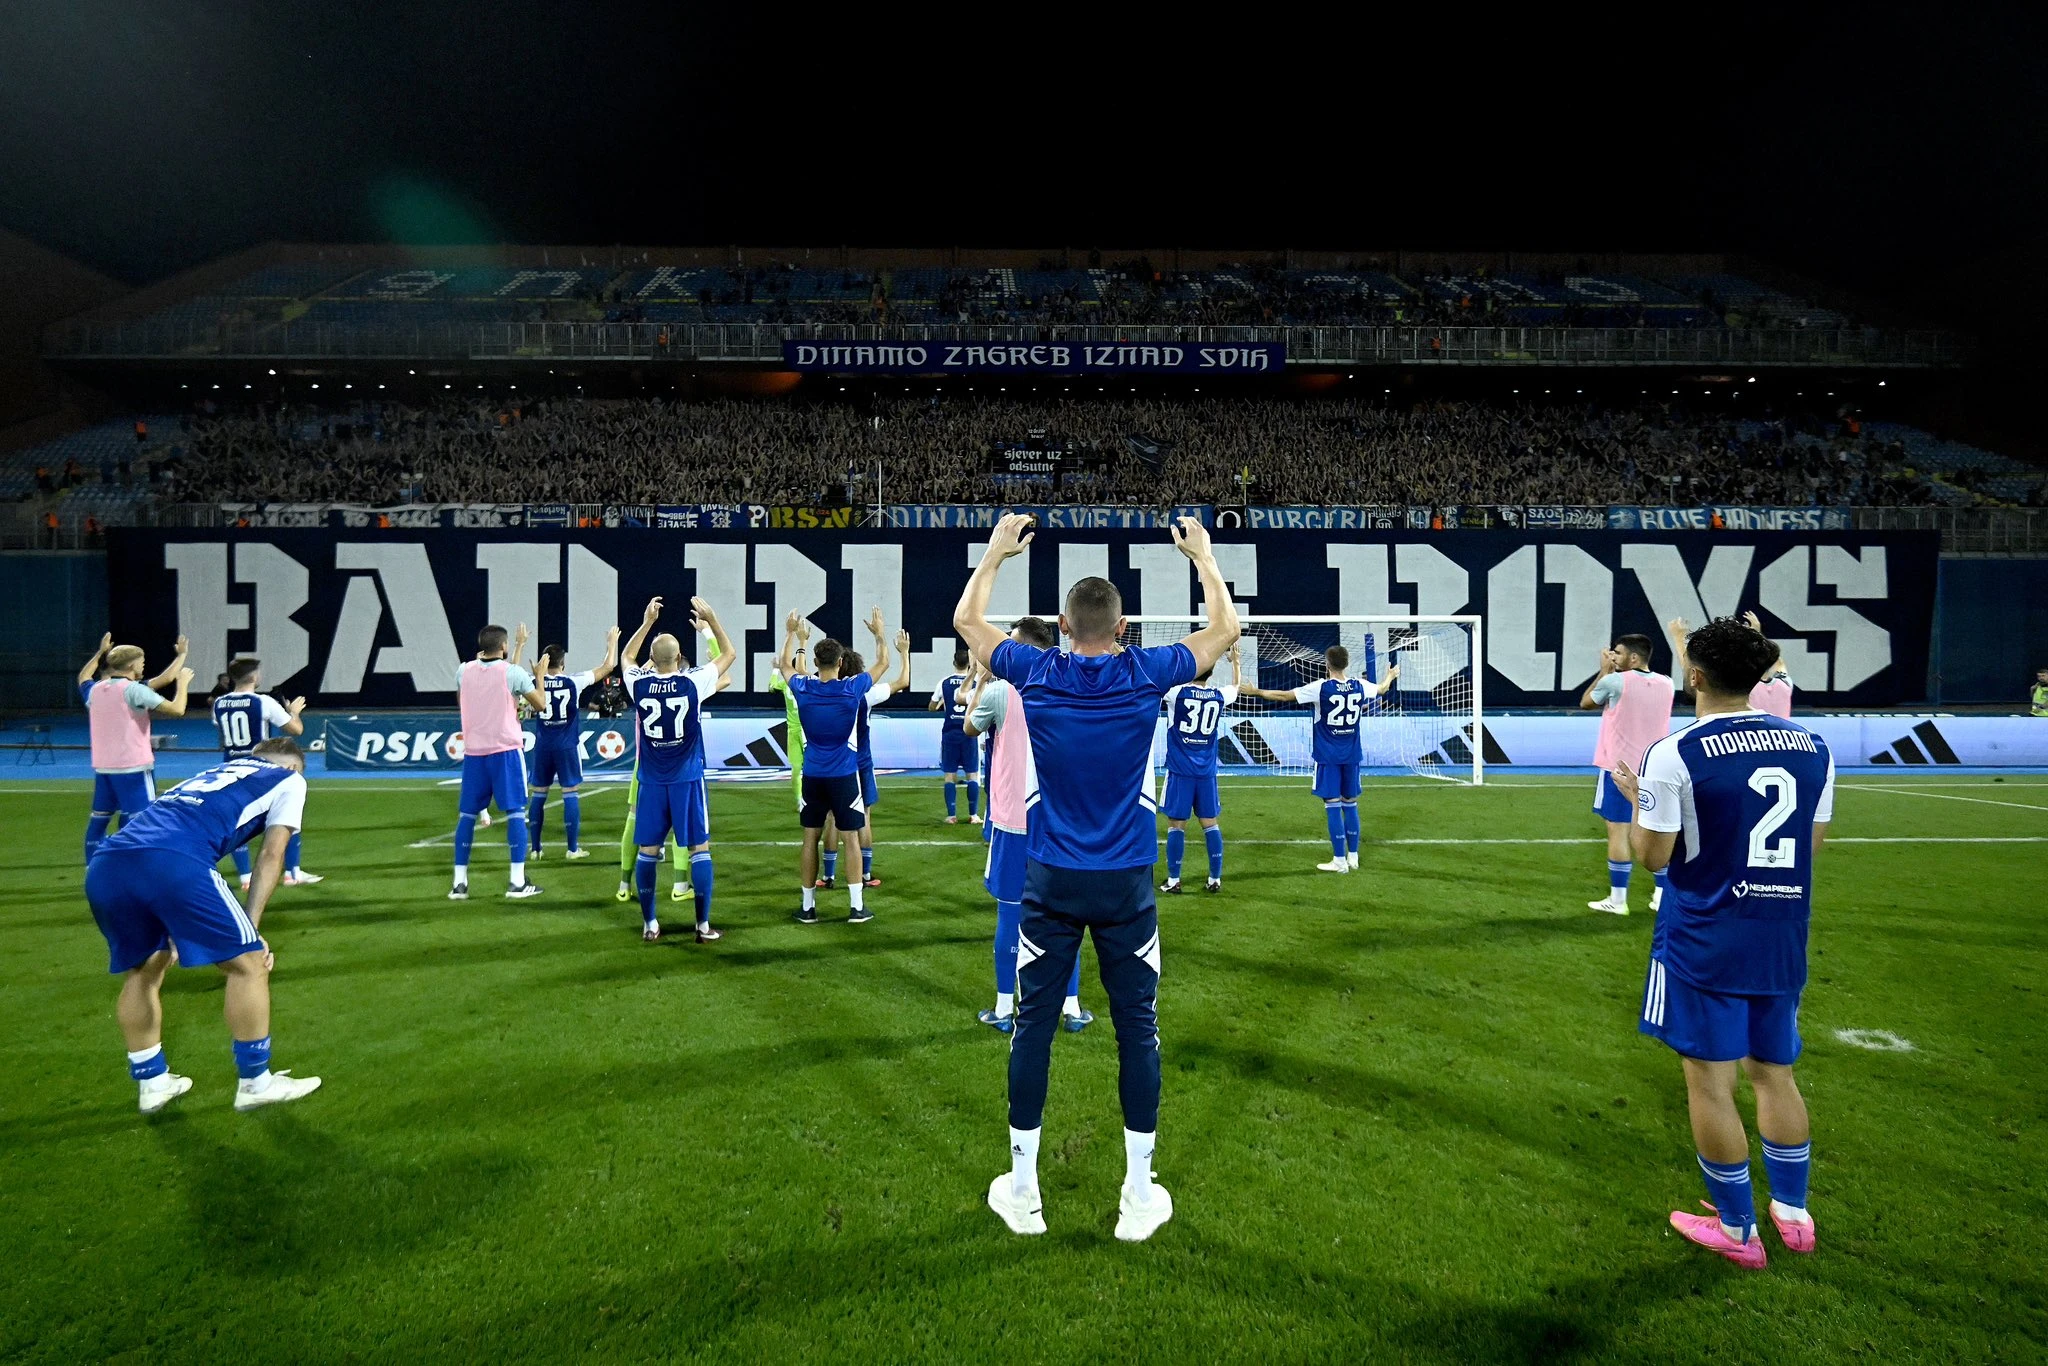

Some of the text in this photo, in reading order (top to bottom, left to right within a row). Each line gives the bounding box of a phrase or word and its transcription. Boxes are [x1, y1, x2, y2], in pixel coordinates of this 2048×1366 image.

[796, 345, 928, 366] DINAMO
[943, 346, 1071, 366] ZAGREB
[1084, 347, 1184, 366] IZNAD
[1004, 448, 1062, 461] sjever uz
[165, 543, 618, 693] BAD
[1326, 543, 1892, 693] BOYS
[639, 695, 690, 739] 27
[1179, 698, 1220, 735] 30
[1327, 692, 1362, 726] 25
[220, 710, 252, 747] 10
[1700, 729, 1818, 758] MOHARRAMI
[356, 731, 441, 762] PSK
[1747, 766, 1797, 868] 2
